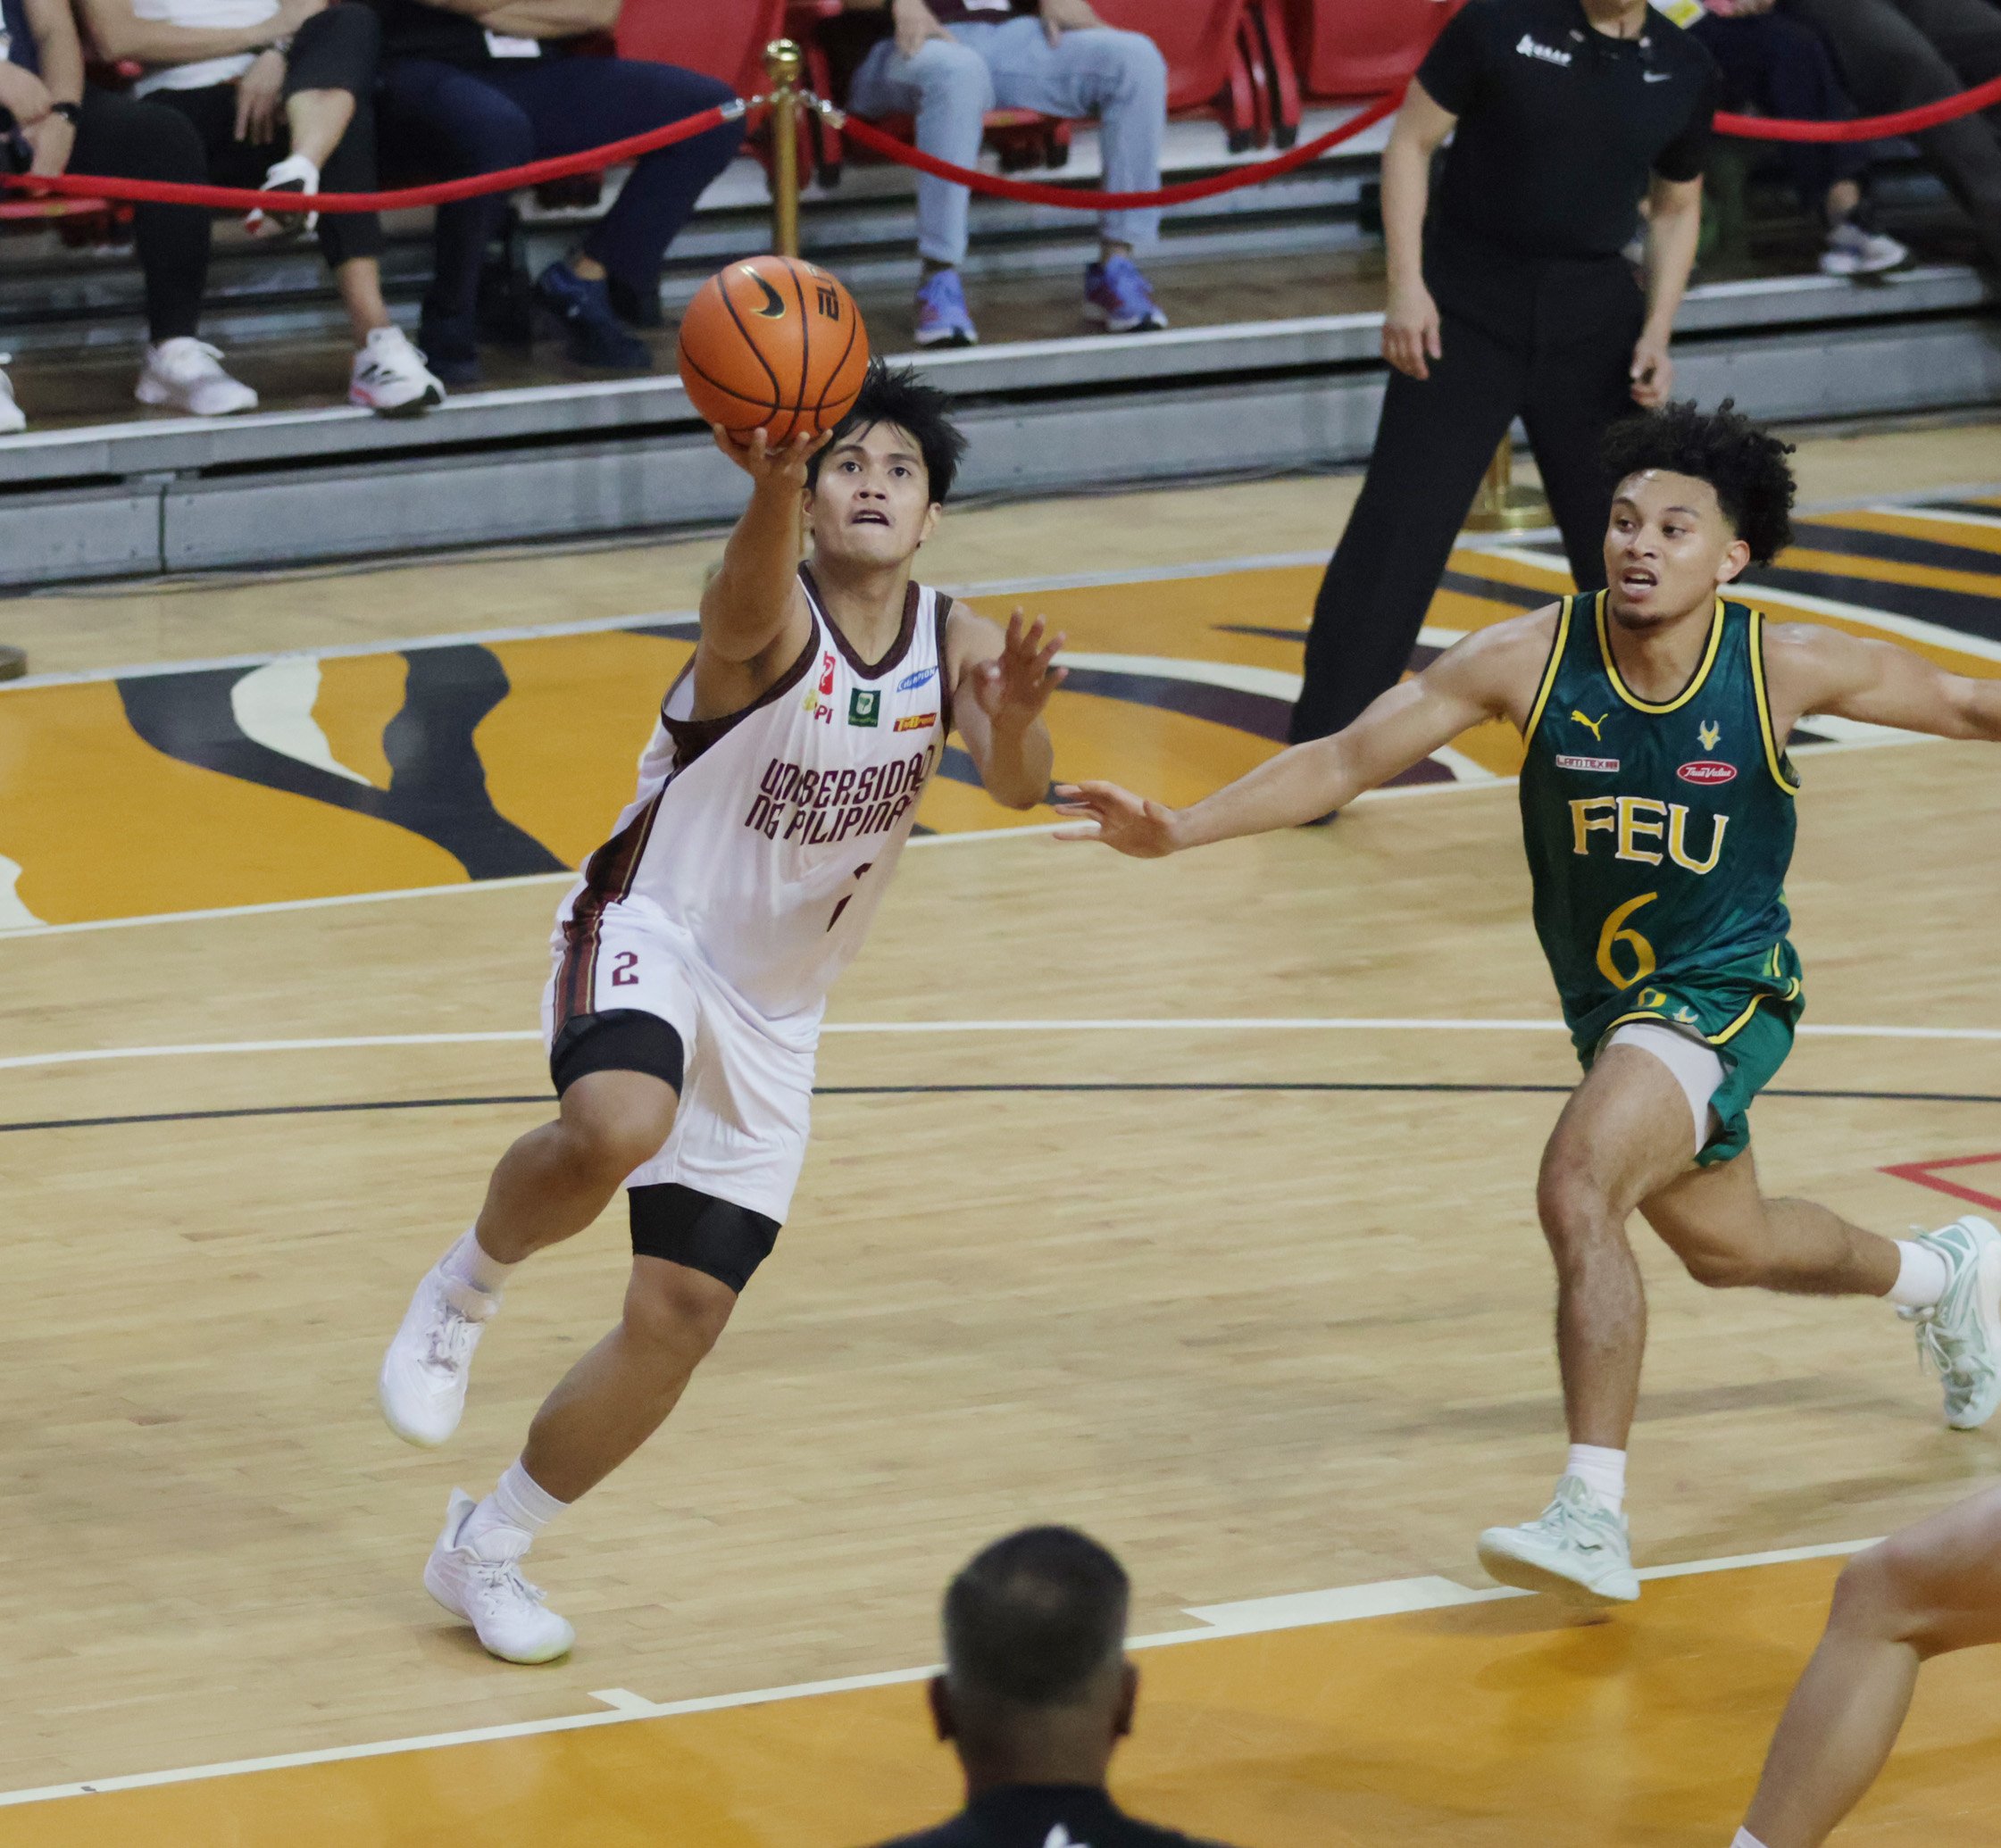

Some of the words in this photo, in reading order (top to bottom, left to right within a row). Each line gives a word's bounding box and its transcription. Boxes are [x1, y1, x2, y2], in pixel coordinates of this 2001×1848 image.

[744, 794, 786, 840] NG
[782, 794, 913, 846] PILIPINA
[1568, 795, 1730, 875] FEU
[612, 951, 639, 987] 2
[1596, 892, 1658, 990] 6
